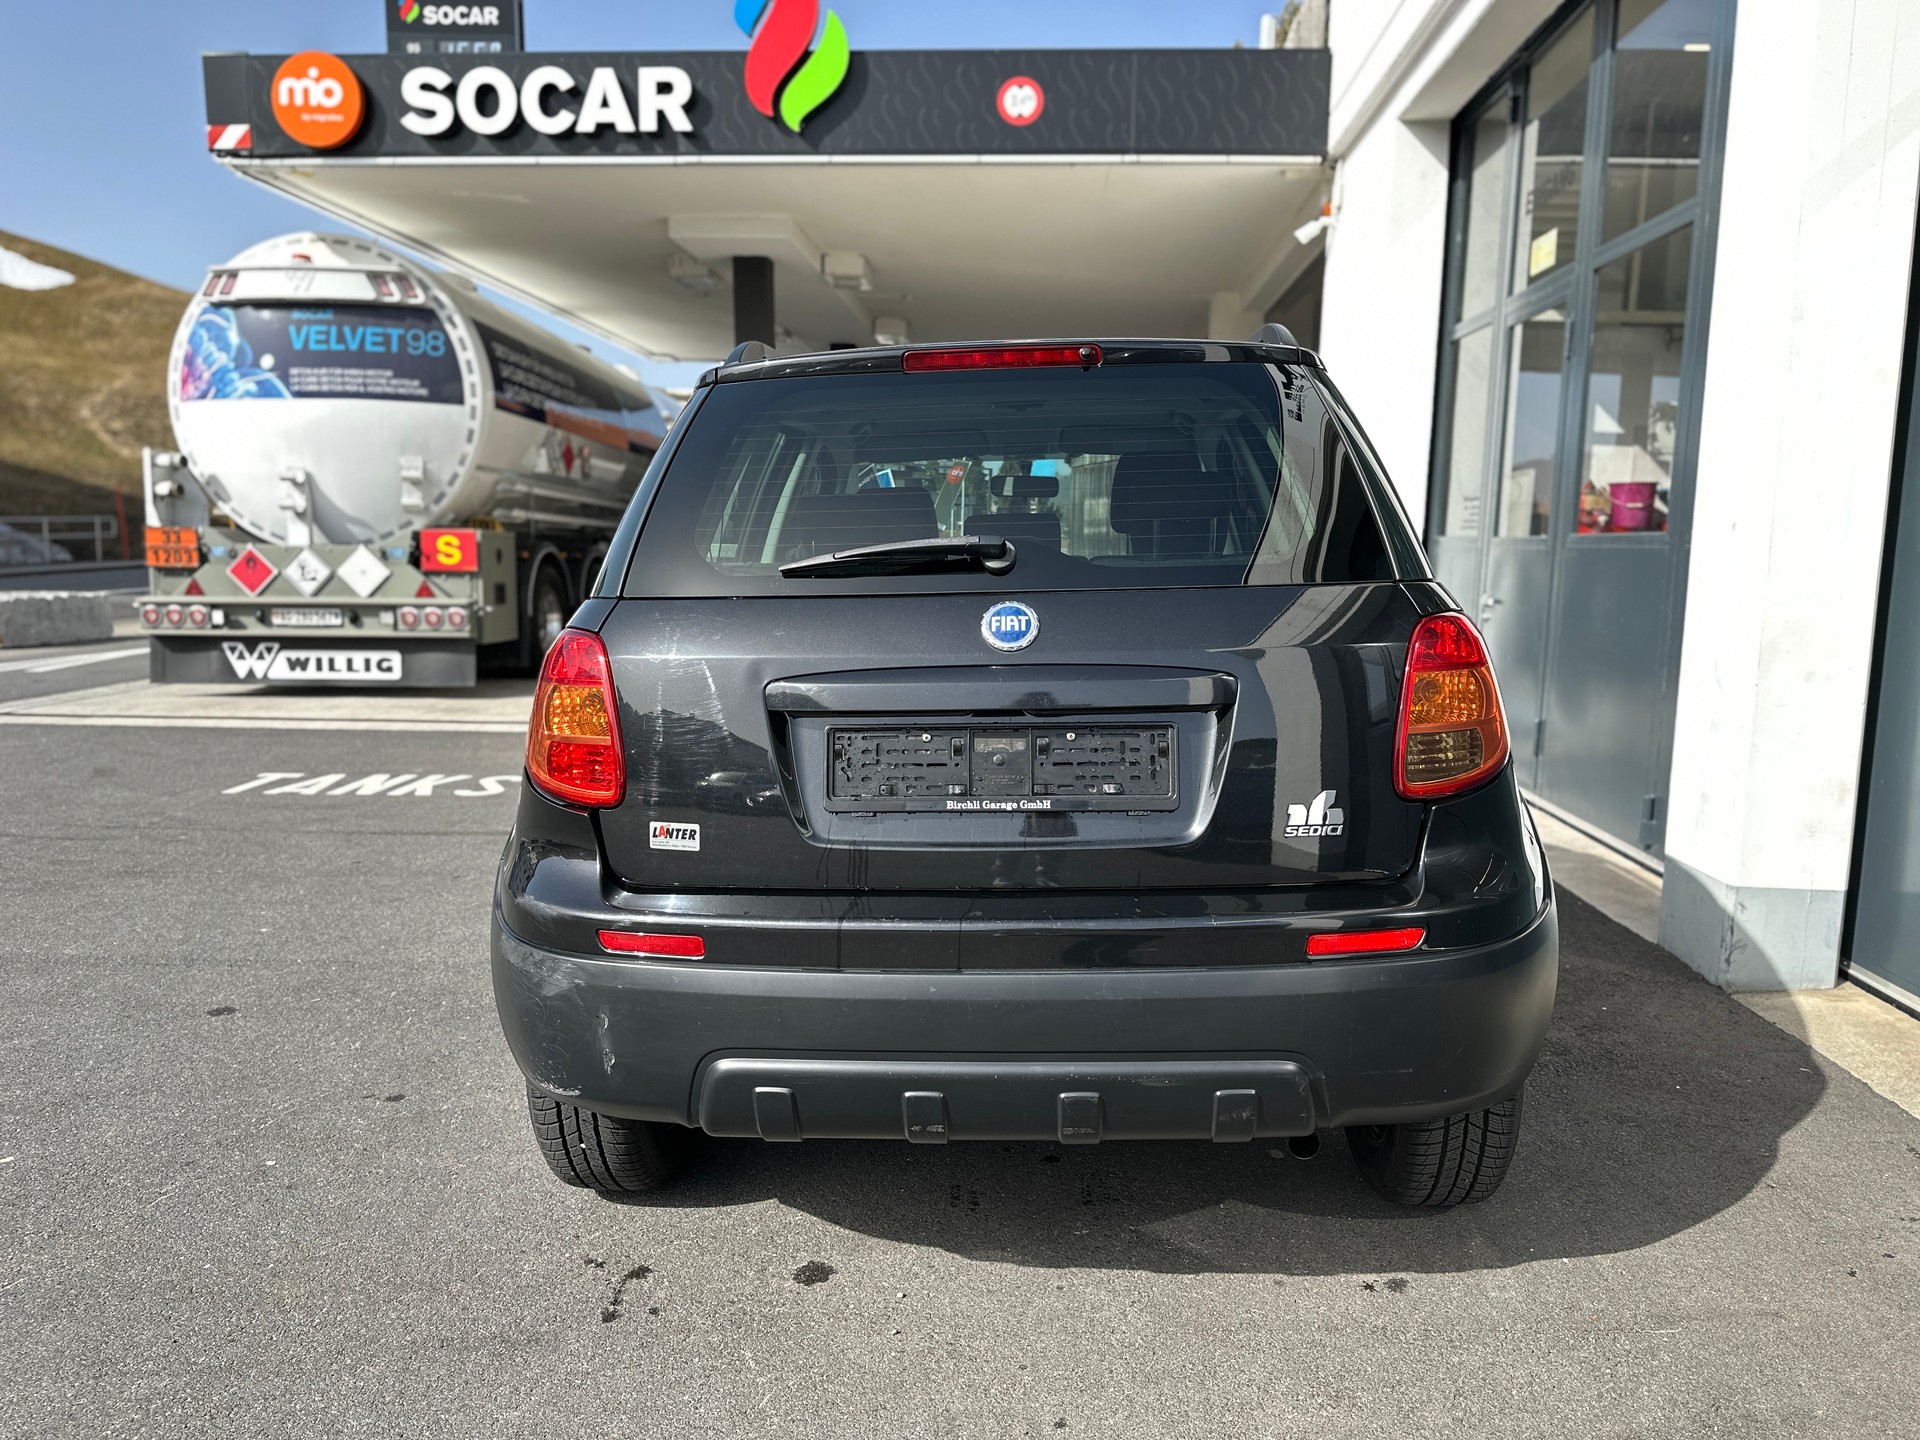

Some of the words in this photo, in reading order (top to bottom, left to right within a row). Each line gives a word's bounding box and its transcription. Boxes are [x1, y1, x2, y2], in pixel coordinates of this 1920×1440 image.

[422, 5, 499, 25] SOCAR
[278, 66, 344, 109] mio
[400, 66, 693, 136] SOCAR
[163, 531, 181, 543] 33
[154, 549, 194, 564] 1203
[436, 534, 462, 566] S
[991, 615, 1029, 632] FIAT
[286, 656, 394, 673] WILLIG
[946, 800, 980, 810] Birchli
[982, 800, 1018, 811] Garage
[1020, 800, 1051, 809] GmbH
[652, 825, 697, 841] LANTER
[1284, 824, 1344, 837] SEDICI
